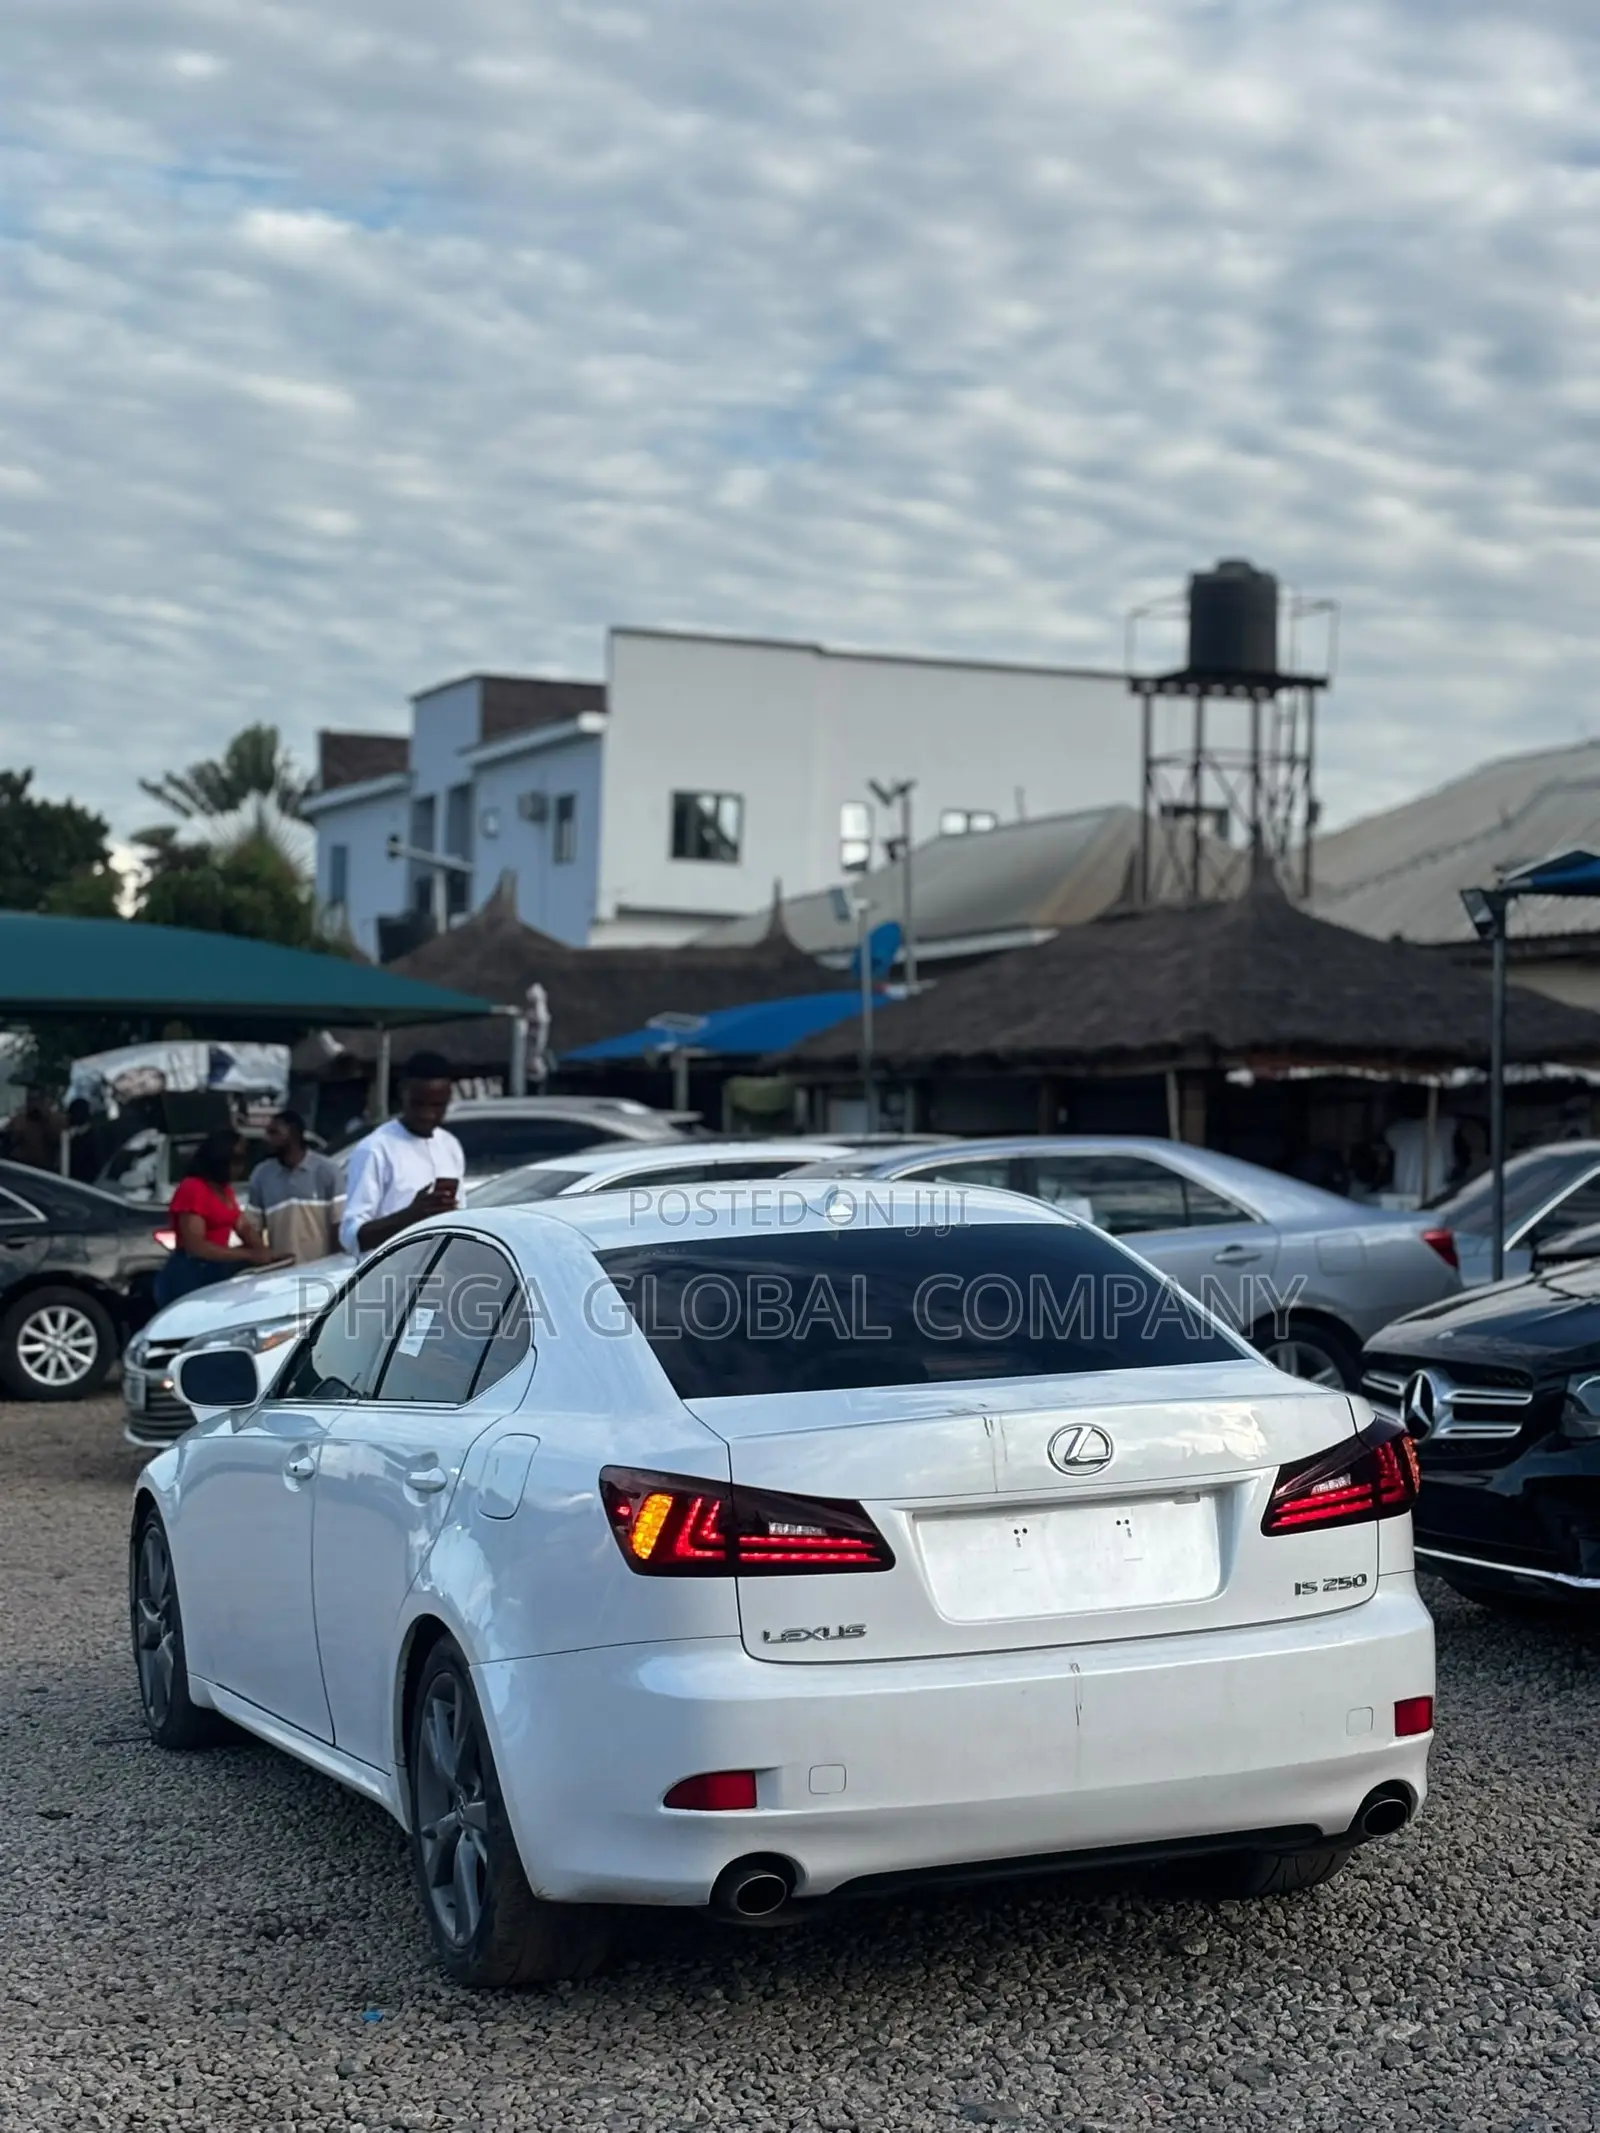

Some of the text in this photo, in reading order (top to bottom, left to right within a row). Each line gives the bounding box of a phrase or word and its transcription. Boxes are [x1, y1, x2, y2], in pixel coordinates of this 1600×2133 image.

[1294, 1573, 1367, 1596] IS 250
[762, 1623, 867, 1644] LEXUS
